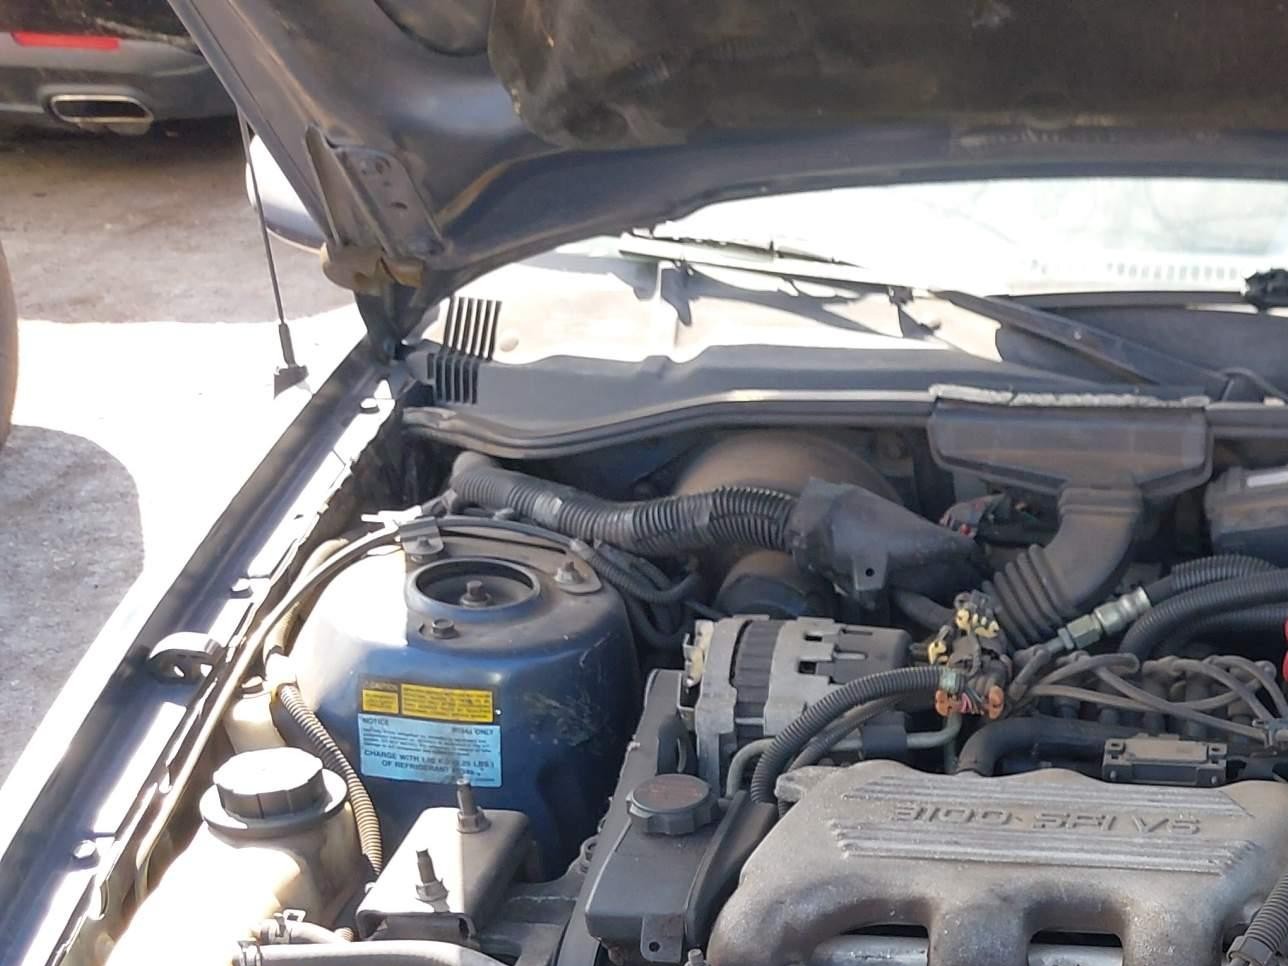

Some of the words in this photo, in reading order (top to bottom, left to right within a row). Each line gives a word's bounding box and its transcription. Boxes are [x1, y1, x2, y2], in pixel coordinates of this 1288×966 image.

[362, 718, 389, 726] NOTICE
[364, 750, 397, 759] CHARGE
[400, 754, 420, 762] WITH
[395, 761, 449, 772] REFRIGERANT
[1134, 816, 1201, 835] V6
